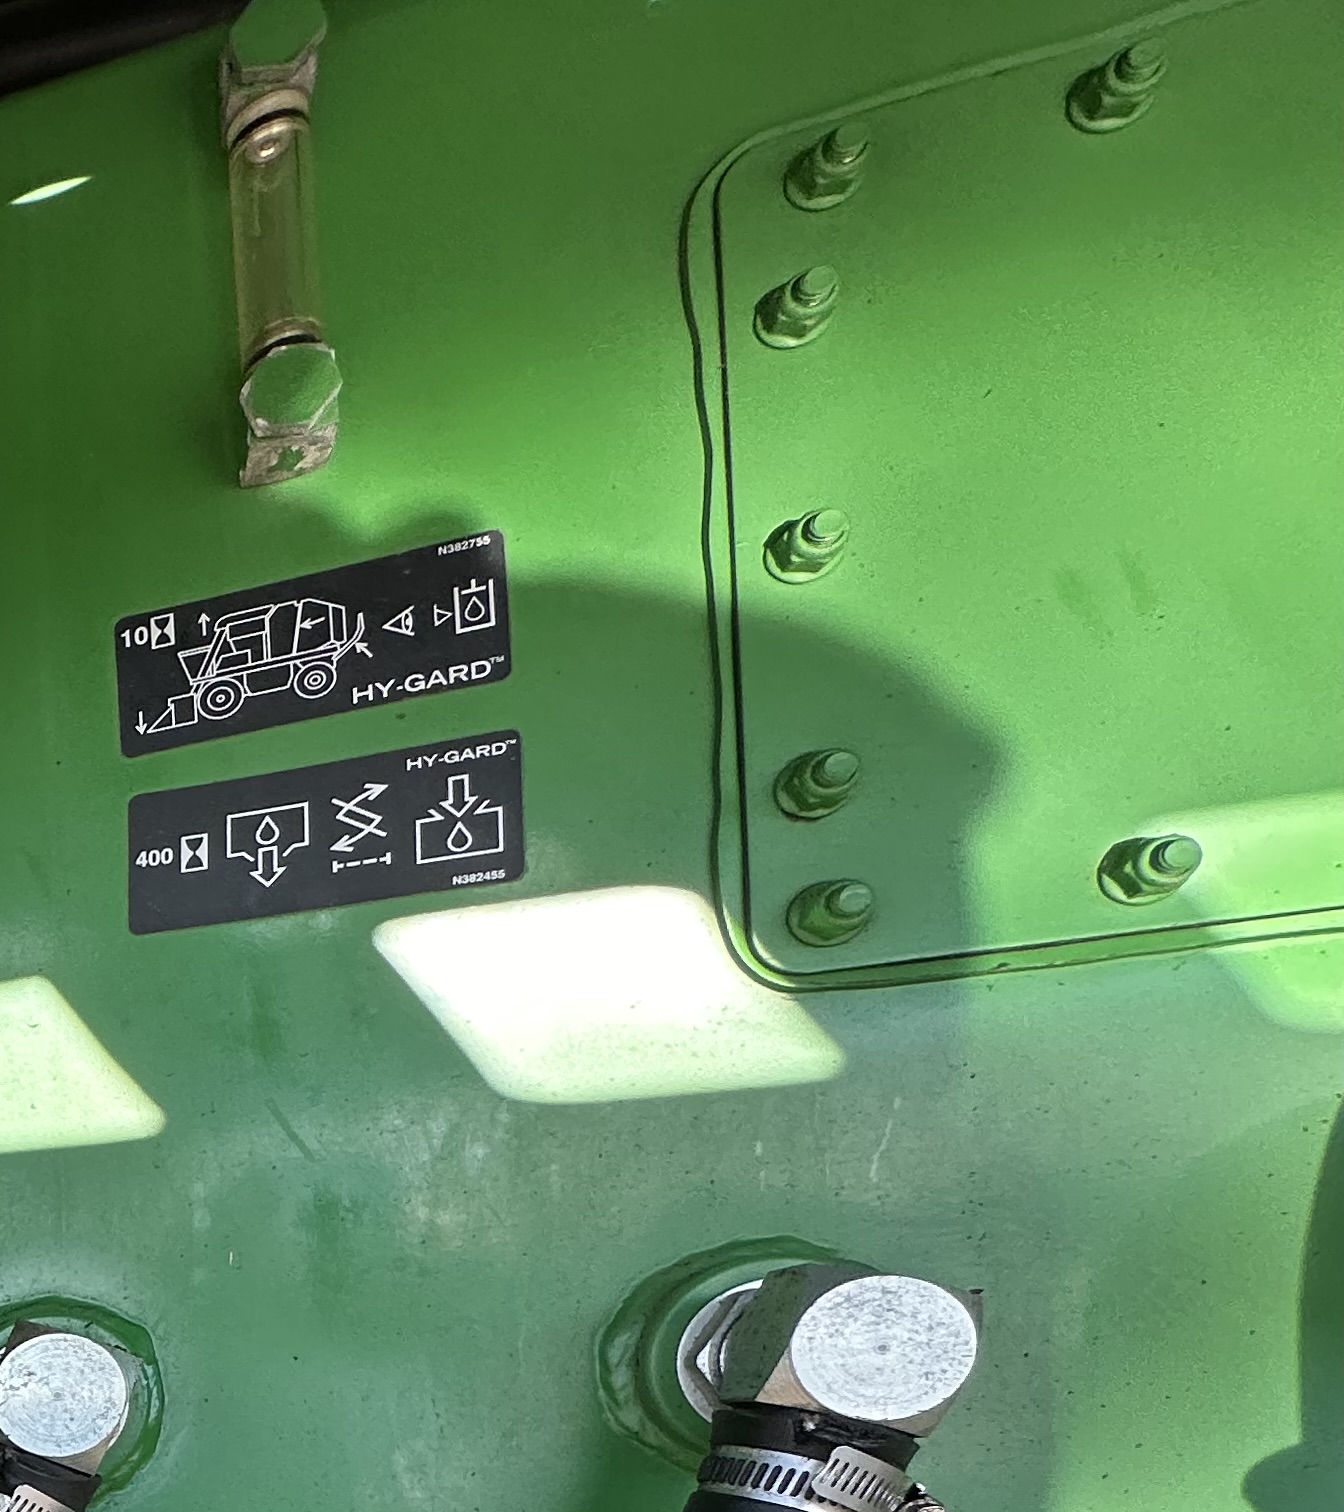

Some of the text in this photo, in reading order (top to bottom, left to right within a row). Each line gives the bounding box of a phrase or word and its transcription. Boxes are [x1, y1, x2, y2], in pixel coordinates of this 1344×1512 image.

[438, 535, 491, 556] N382755
[121, 626, 149, 648] 10
[135, 847, 174, 869] 400
[452, 869, 506, 887] N382455
